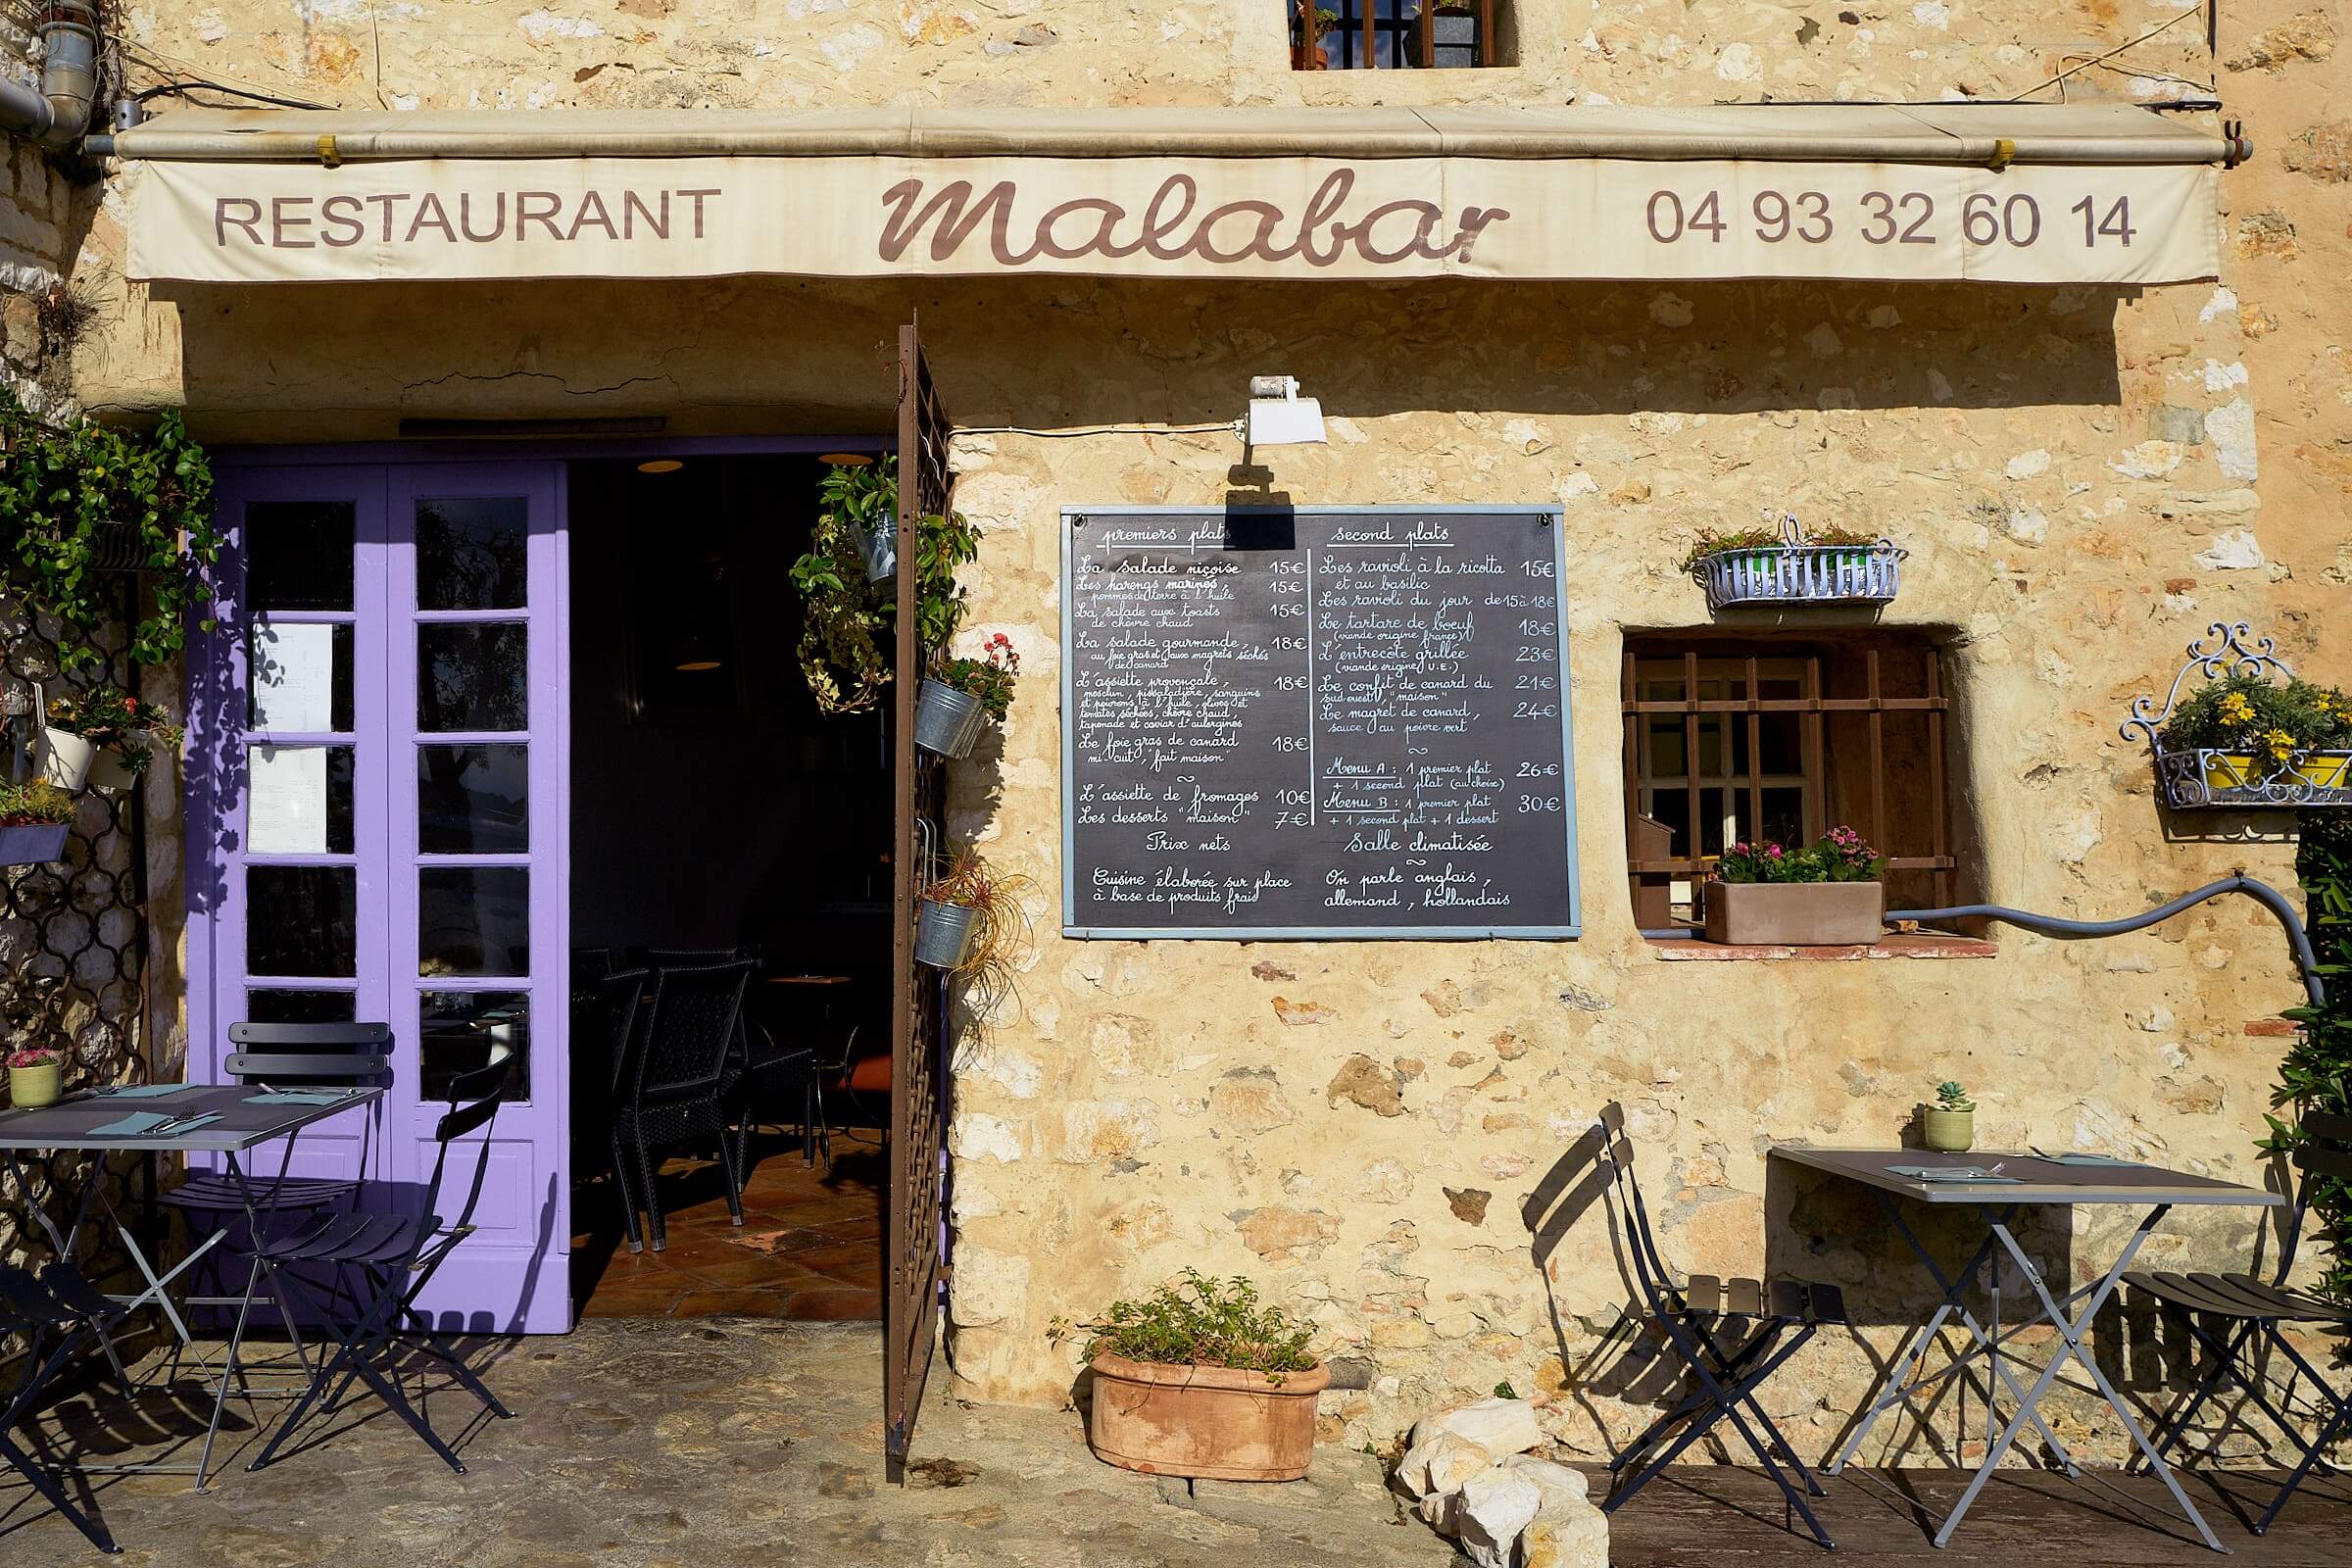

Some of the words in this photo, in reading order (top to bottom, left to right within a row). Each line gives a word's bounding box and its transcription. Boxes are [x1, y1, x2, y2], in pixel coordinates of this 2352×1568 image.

[215, 187, 722, 249] RESTAURANT
[1646, 190, 1727, 244] 04
[1752, 190, 1834, 244] 93
[1860, 191, 1936, 245] 32
[1962, 193, 2040, 248] 60
[2071, 194, 2137, 248] 14
[1102, 526, 1177, 555] premiers
[1332, 522, 1394, 541] second
[1405, 522, 1449, 551] plats
[1077, 556, 1103, 574] La
[1115, 557, 1177, 574] salade
[1187, 560, 1242, 577] niçoise
[1268, 562, 1305, 574] 15€
[1319, 555, 1352, 573] Les
[1358, 553, 1411, 573] ravioli
[1417, 558, 1432, 573] à
[1434, 557, 1451, 574] la
[1457, 555, 1505, 575] ricotta
[1520, 561, 1554, 577] 15€
[1076, 576, 1101, 590] Les
[1105, 574, 1159, 601] harengs
[1268, 581, 1304, 593] 15€
[1335, 578, 1351, 590] et
[1381, 574, 1431, 590] basilic
[1074, 603, 1097, 617] La
[1102, 604, 1145, 618] salade
[1180, 604, 1221, 616] toasts
[1270, 605, 1305, 617] 15€
[1319, 591, 1348, 607] Les
[1351, 591, 1403, 607] ravioli
[1410, 594, 1432, 606] du
[1440, 592, 1473, 616] jour
[1485, 592, 1502, 606] de
[1503, 596, 1518, 608] 15
[1519, 596, 1529, 607] à
[1531, 596, 1554, 609] 18€
[1092, 618, 1106, 628] de
[1111, 617, 1151, 627] chèvre
[1156, 617, 1194, 628] chaud
[1319, 612, 1342, 630] Le
[1346, 612, 1400, 629] tartare
[1407, 616, 1427, 629] de
[1519, 619, 1555, 636] 18€
[1076, 631, 1100, 649] La
[1106, 631, 1155, 649] salade
[1271, 636, 1307, 650] 18€
[1104, 649, 1126, 669] foie
[1128, 650, 1150, 667] gras
[1169, 651, 1189, 660] aux
[1192, 649, 1232, 670] magrets
[1133, 660, 1169, 669] canard
[1416, 642, 1469, 673] grillée
[1515, 647, 1556, 662] 23€
[1273, 676, 1308, 690] 18€
[1318, 675, 1342, 692] Le
[1349, 673, 1394, 703] confit
[1399, 677, 1414, 689] de
[1421, 677, 1468, 689] canard
[1474, 675, 1494, 689] du
[1515, 676, 1556, 691] 21€
[1079, 708, 1115, 718] tomates
[1161, 707, 1193, 718] chèvre
[1130, 718, 1141, 728] et
[1319, 704, 1344, 720] Le
[1348, 706, 1396, 734] magret
[1401, 707, 1417, 717] de
[1513, 702, 1557, 720] 24€
[1078, 734, 1100, 749] Le
[1106, 730, 1131, 759] foie
[1135, 737, 1161, 758] gras
[1168, 736, 1184, 746] de
[1190, 730, 1239, 747] canard
[1272, 737, 1308, 753] 18€
[1328, 723, 1363, 733] sauce
[1379, 723, 1395, 732] au
[1404, 722, 1441, 744] poivre
[1327, 758, 1371, 775] Menu
[1420, 764, 1462, 782] premier
[1467, 760, 1491, 780] plat
[1516, 762, 1558, 777] 26€
[1363, 777, 1405, 789] second
[1413, 776, 1443, 798] plat
[1163, 786, 1182, 802] de
[1187, 785, 1259, 816] fromages
[1275, 789, 1310, 805] 10€
[1324, 792, 1371, 808] Menu
[1419, 798, 1459, 815] premier
[1464, 794, 1491, 814] plat
[1519, 795, 1560, 812] 30€
[1078, 806, 1106, 824] Les
[1112, 806, 1168, 823] desserts
[1357, 814, 1398, 825] second
[1402, 814, 1427, 831] plat
[1457, 810, 1499, 824] dessert
[1147, 832, 1189, 851] Prix
[1199, 834, 1230, 851] nets
[1344, 829, 1400, 853] Salle
[1409, 831, 1493, 852] climatisée
[1093, 867, 1146, 886] Cuisine
[1155, 865, 1218, 889] élaborée
[1223, 878, 1248, 888] sur
[1254, 870, 1292, 902] place
[1326, 869, 1349, 886] On
[1360, 866, 1403, 896] parle
[1093, 888, 1105, 901] à
[1110, 886, 1143, 903] base
[1147, 889, 1165, 903] de
[1168, 889, 1221, 915] produits
[1223, 886, 1258, 914] frais
[1423, 884, 1511, 907] hollandais
